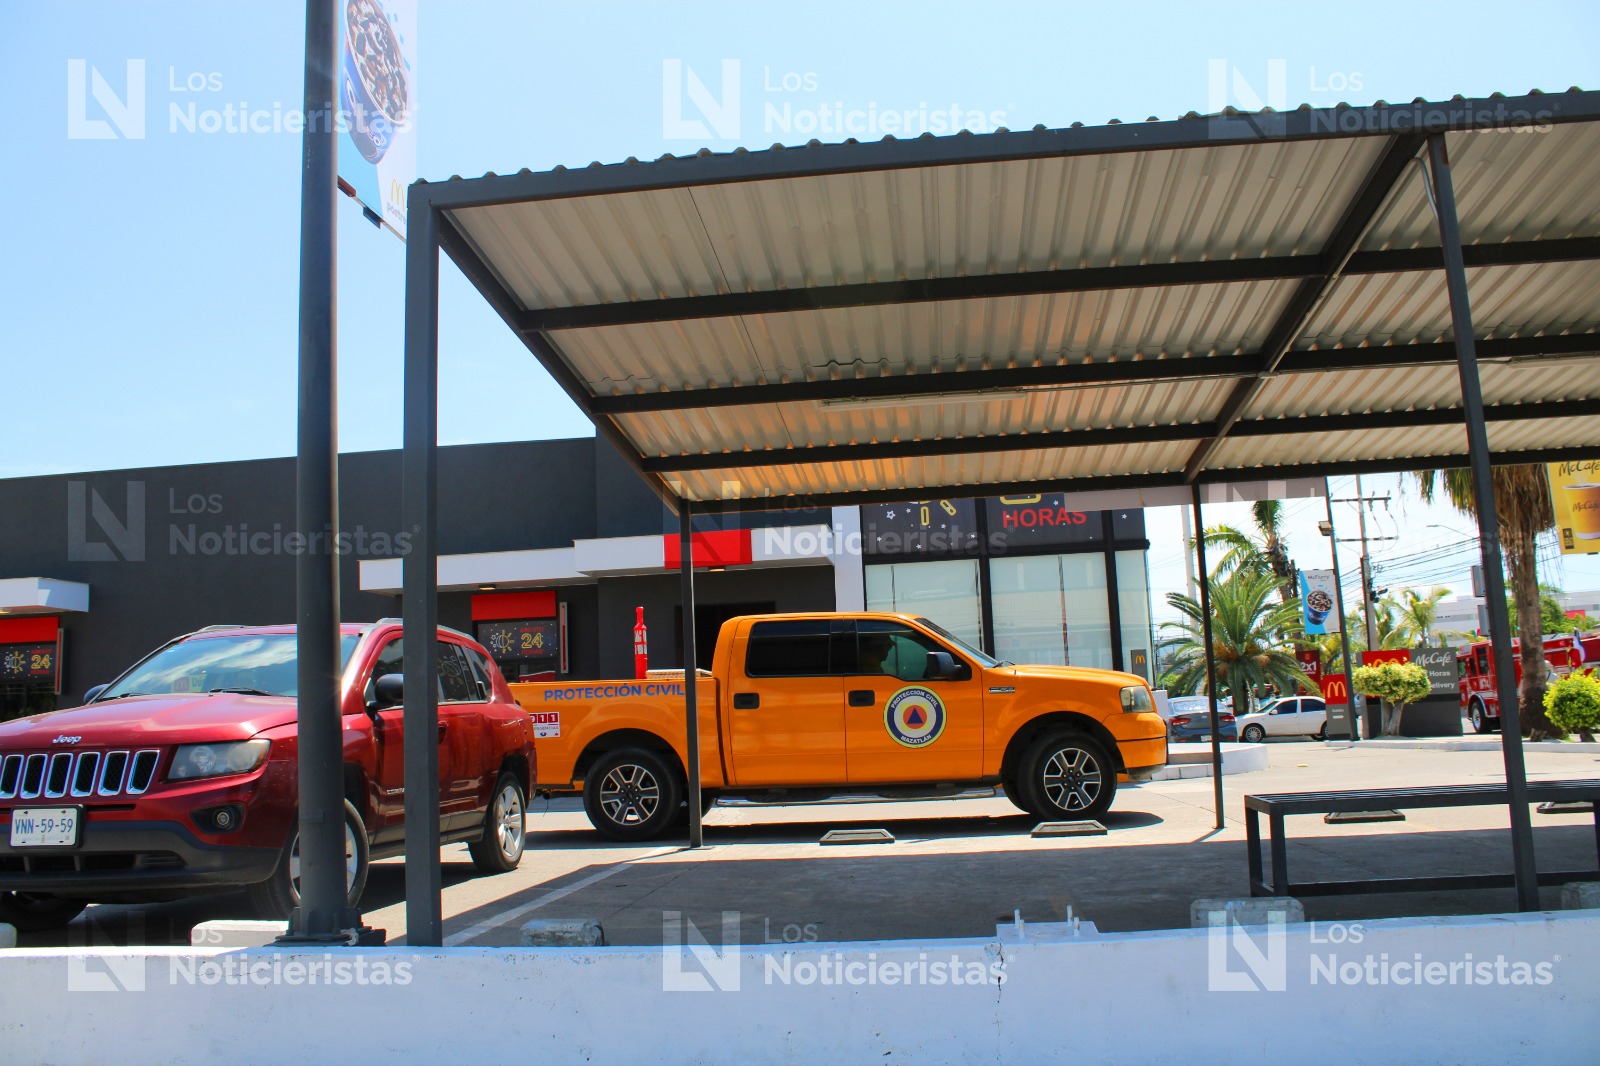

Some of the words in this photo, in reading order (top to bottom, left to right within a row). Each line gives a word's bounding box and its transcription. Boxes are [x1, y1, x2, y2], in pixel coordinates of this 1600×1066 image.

[1002, 507, 1087, 528] HORAS
[521, 632, 543, 648] 24
[31, 654, 51, 669] 24
[1300, 661, 1317, 672] 2x1
[544, 683, 642, 701] PROTECCIÓN
[645, 684, 685, 696] CIVIL
[890, 690, 925, 709] PROTECCIÓN
[925, 693, 938, 708] CIVIL
[52, 735, 82, 744] Jeep
[900, 734, 932, 744] MAZATLÁN
[15, 818, 73, 834] VNN-59-59
